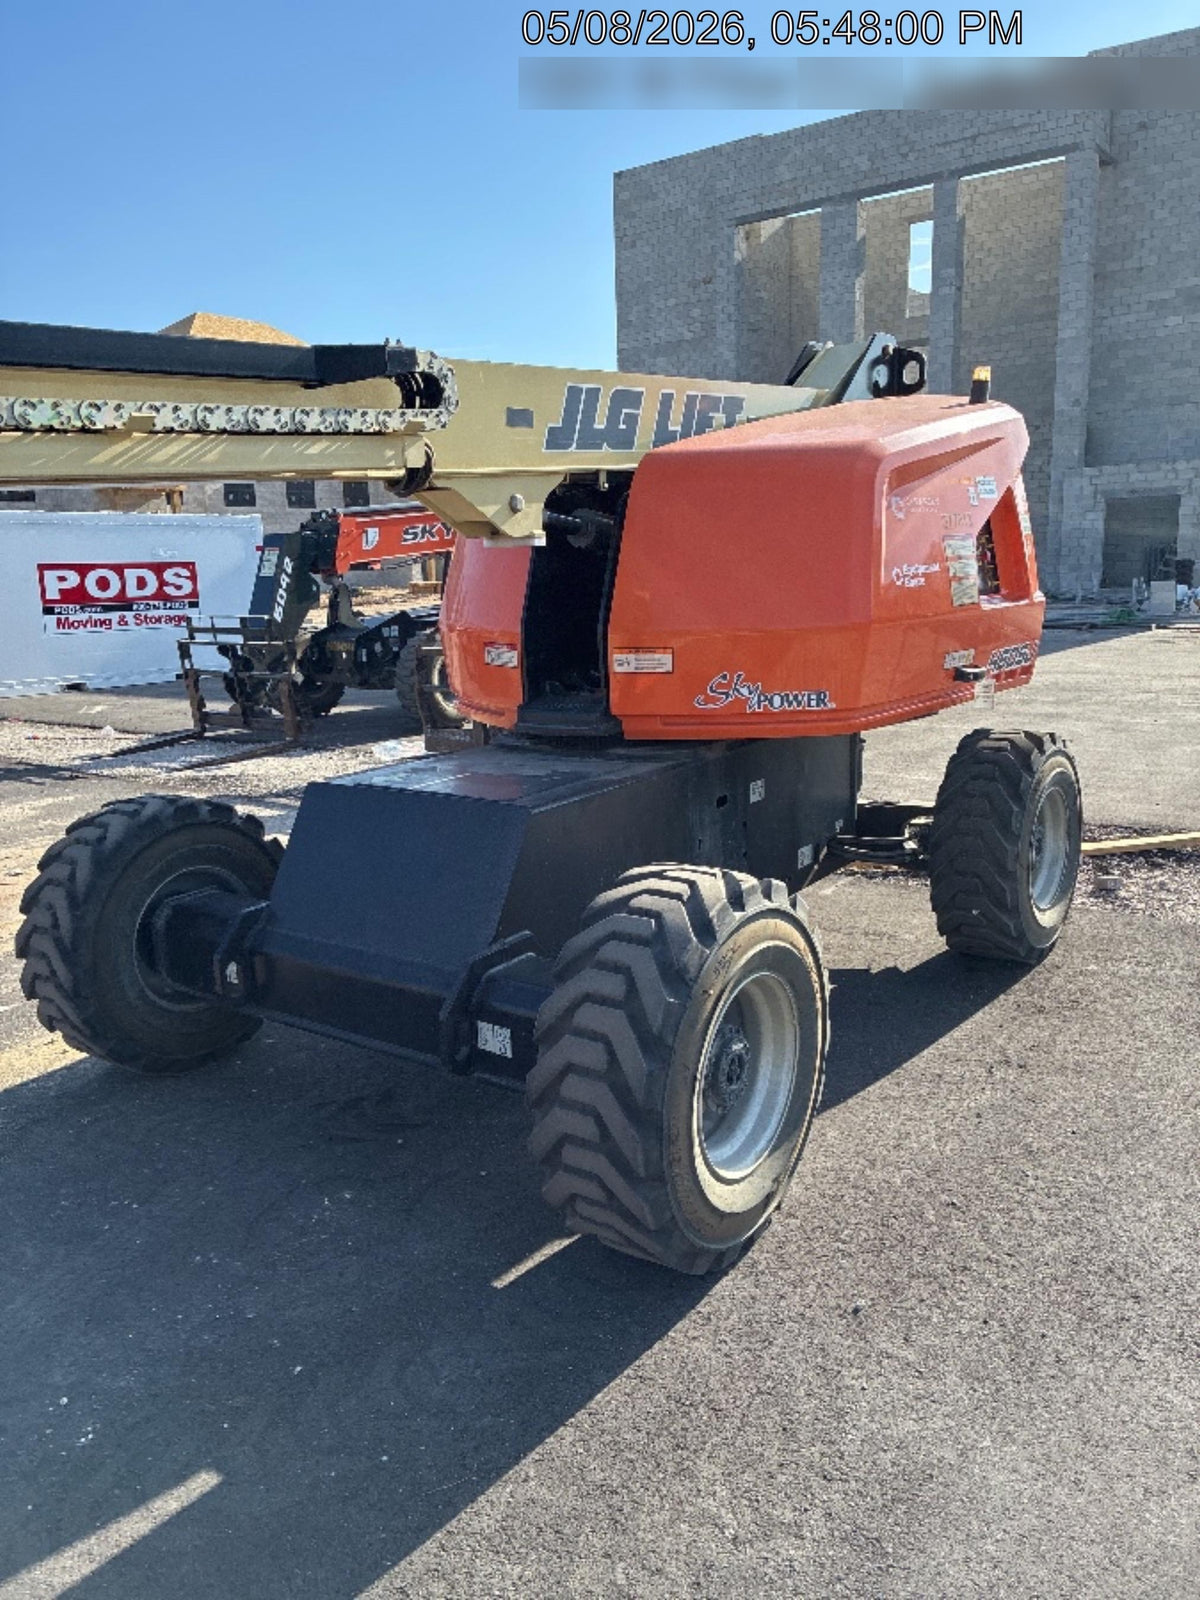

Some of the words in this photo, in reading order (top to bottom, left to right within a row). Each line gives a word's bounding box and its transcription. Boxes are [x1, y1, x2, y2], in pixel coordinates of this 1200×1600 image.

[542, 382, 646, 452] JLG
[650, 388, 747, 450] LIFT
[43, 567, 194, 600] PODS
[56, 615, 113, 630] Moving
[116, 614, 129, 626] &
